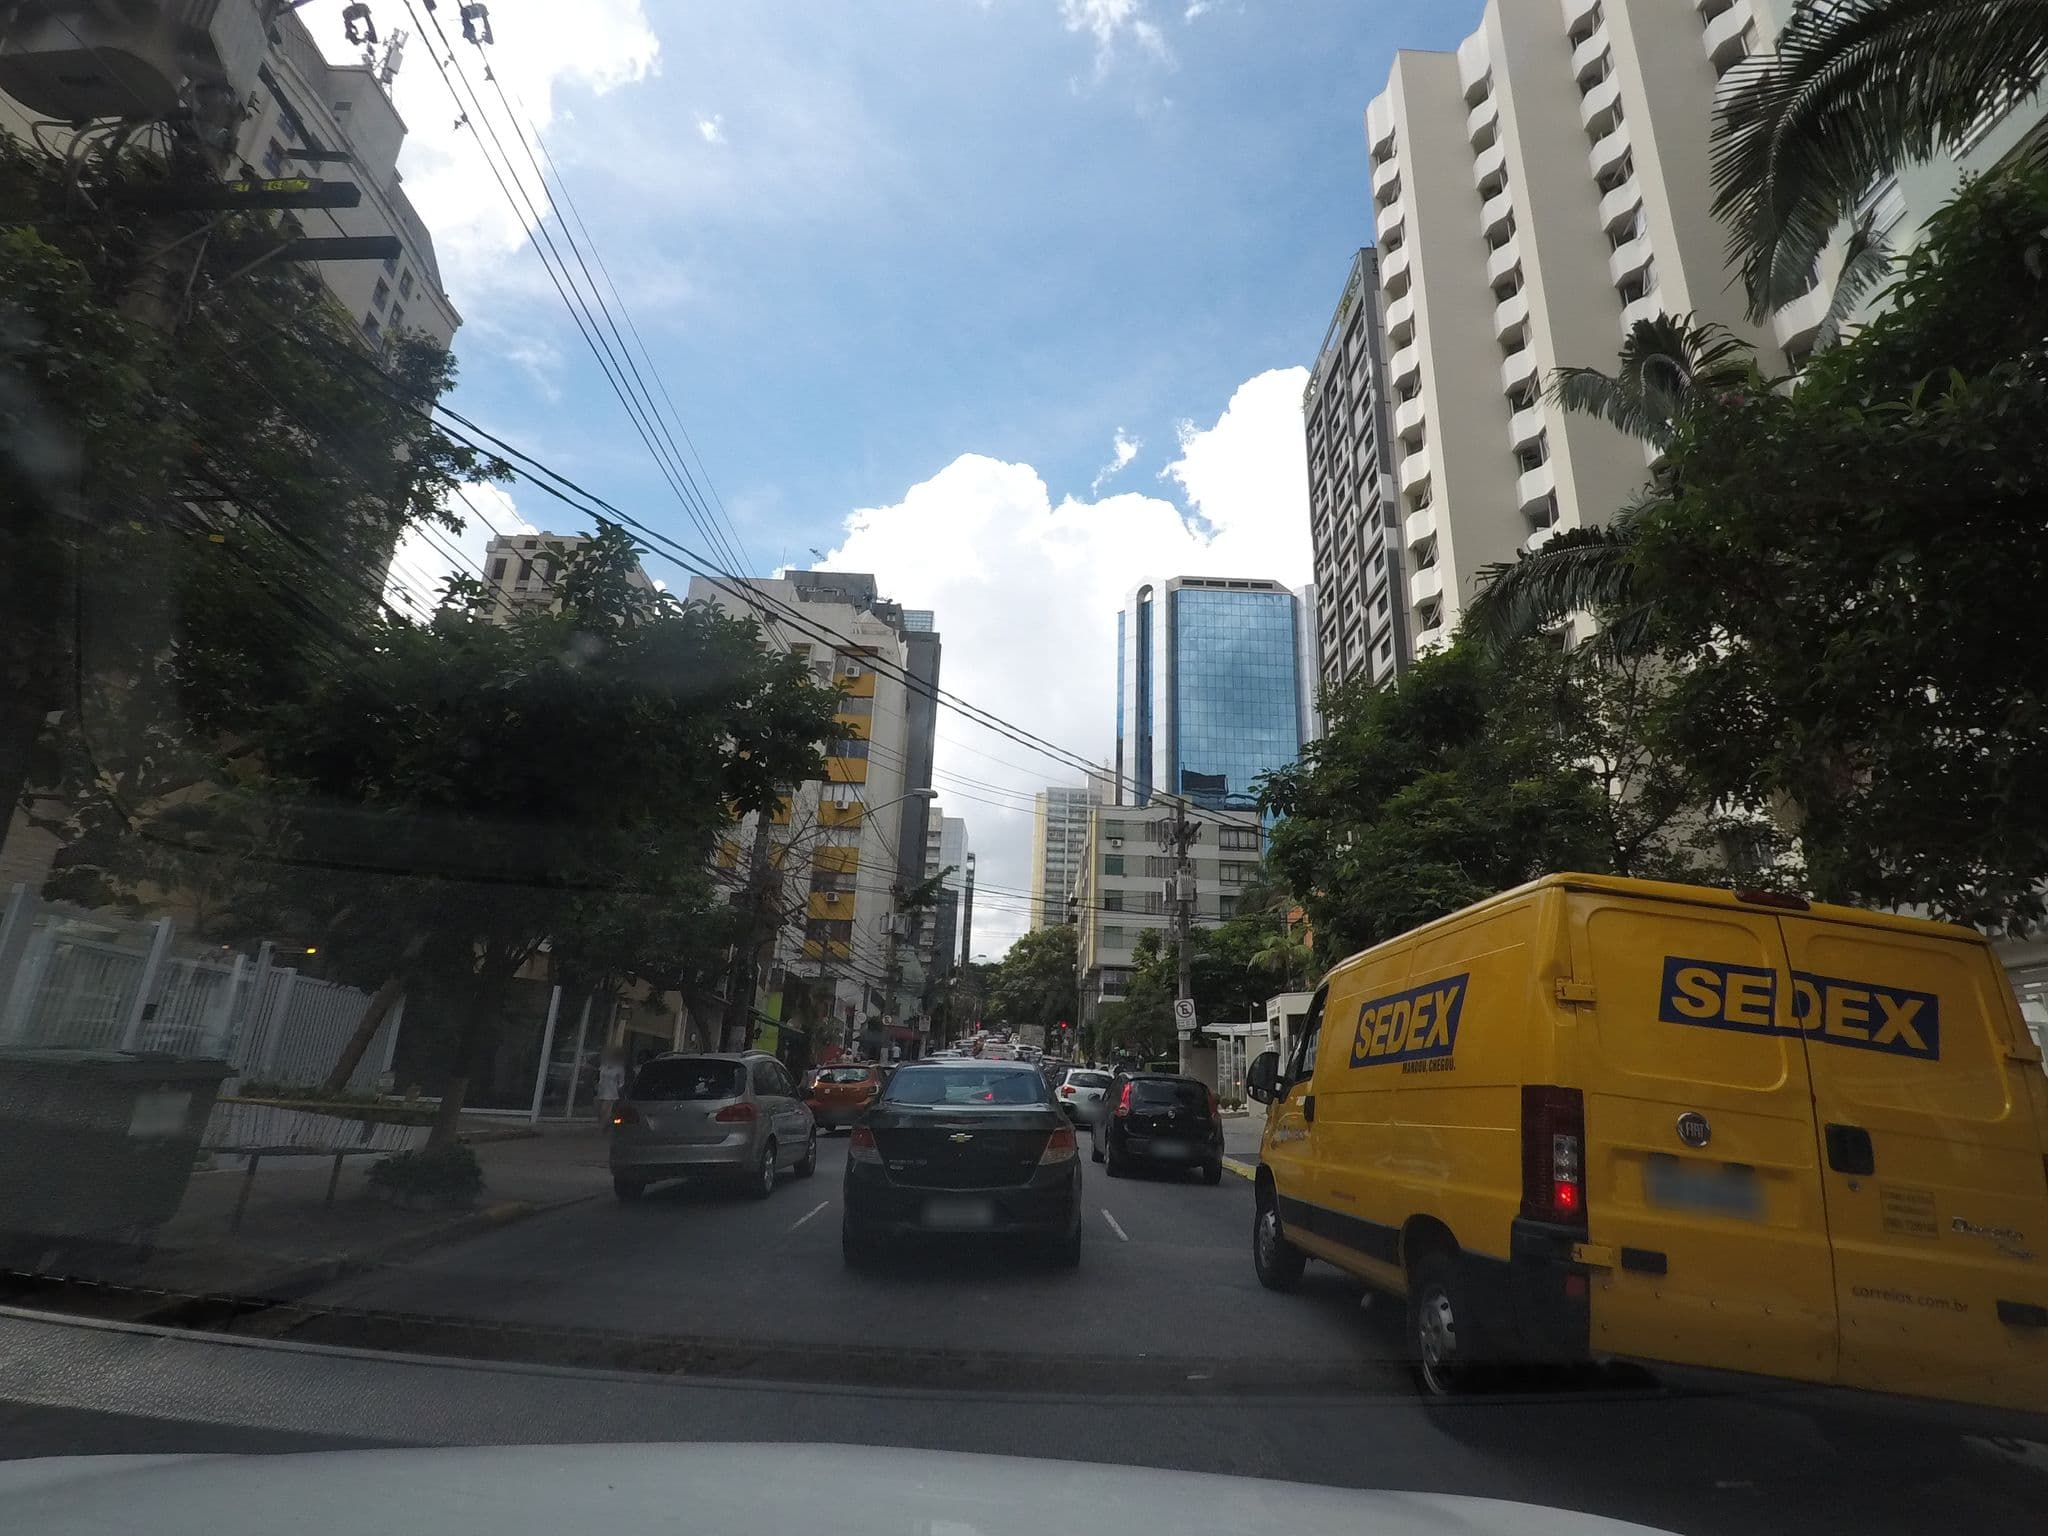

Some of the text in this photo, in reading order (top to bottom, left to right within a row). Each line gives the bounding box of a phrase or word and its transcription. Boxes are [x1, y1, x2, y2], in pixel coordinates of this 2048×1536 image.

[1355, 986, 1460, 1059] SEDEX
[1671, 967, 1928, 1050] SEDEX
[1685, 1120, 1705, 1138] FIAT
[1852, 1286, 1969, 1312] correios.com.br
